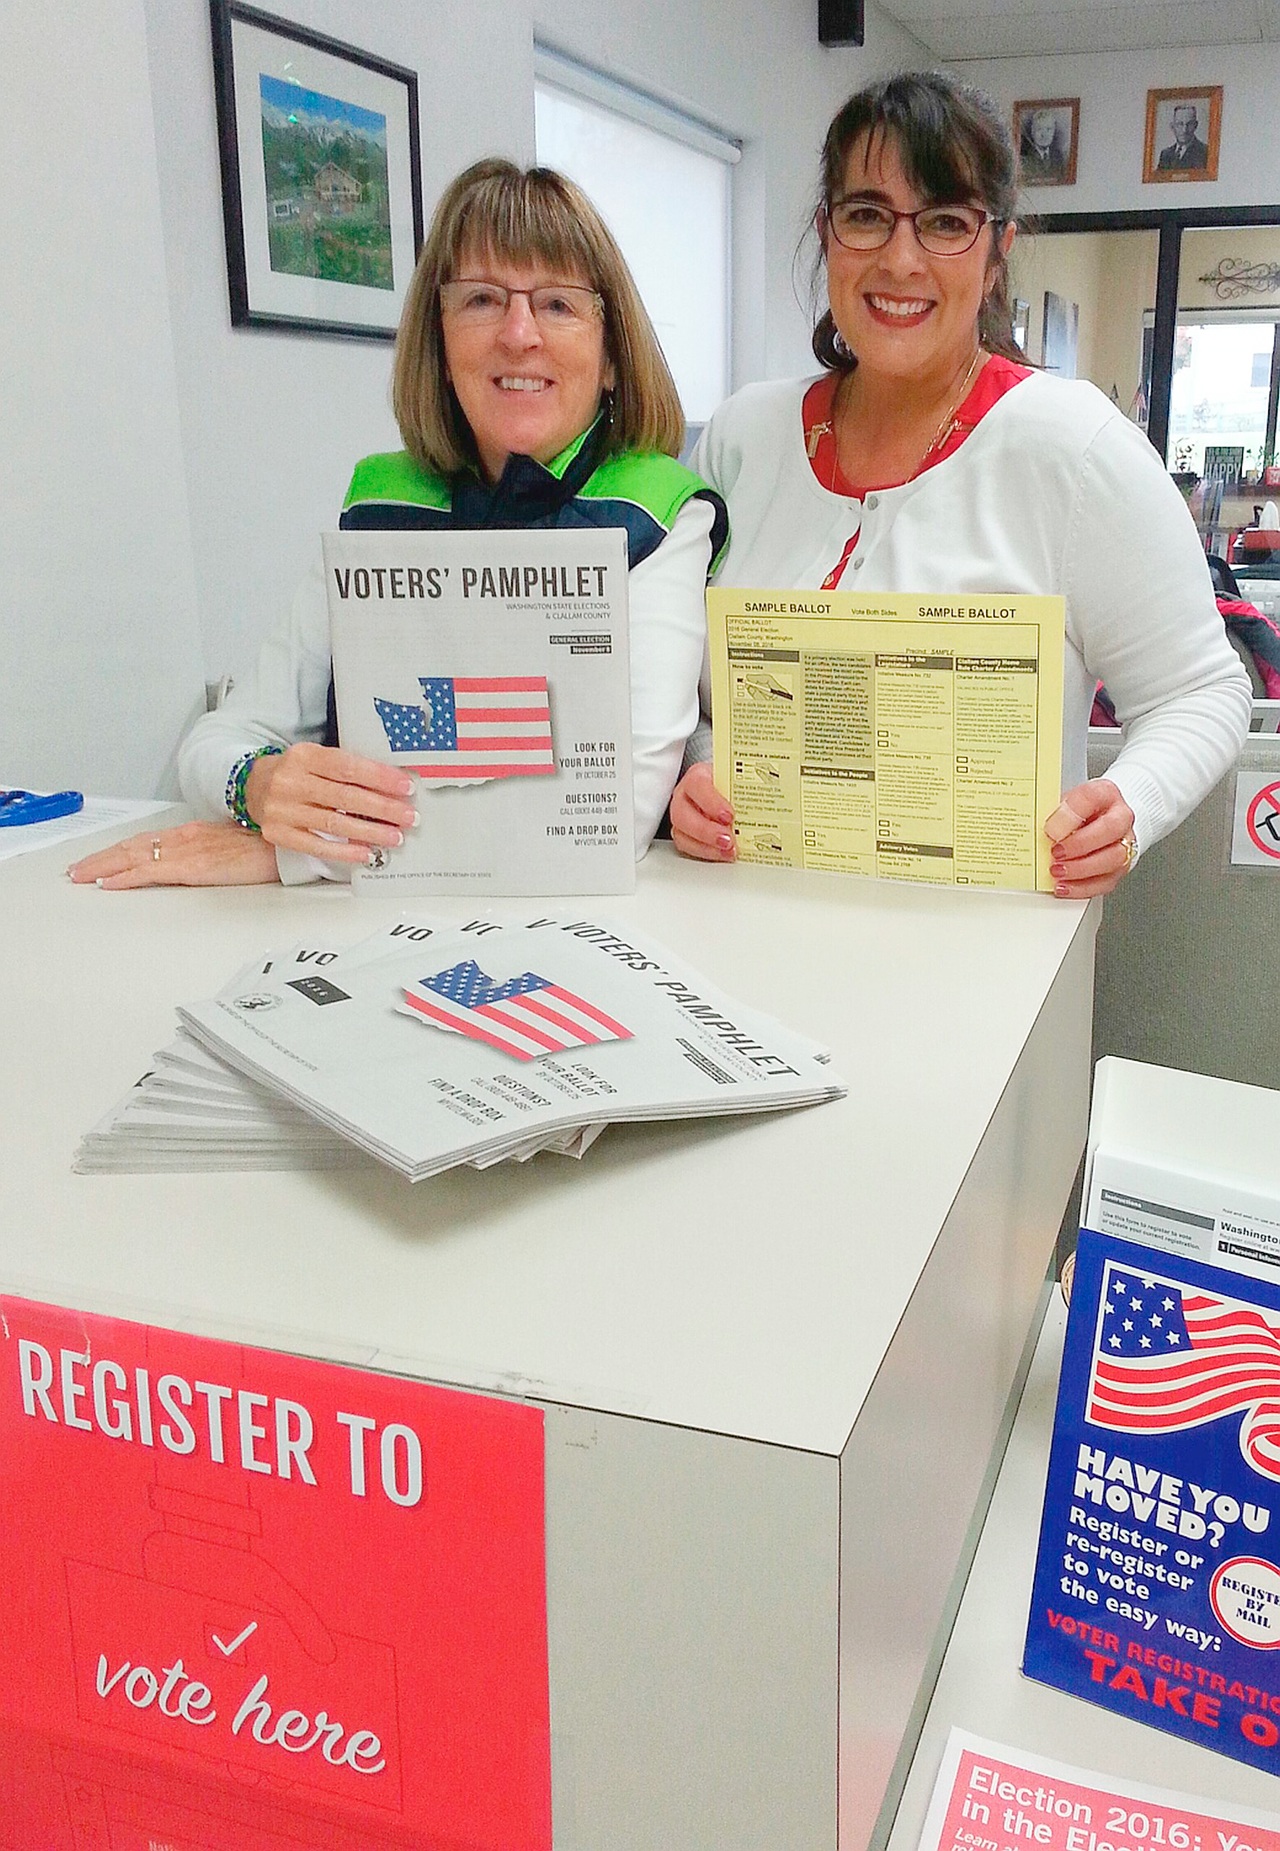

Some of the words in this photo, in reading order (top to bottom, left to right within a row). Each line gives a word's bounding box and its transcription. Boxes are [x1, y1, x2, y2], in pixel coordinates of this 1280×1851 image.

[1205, 463, 1241, 484] HAPPY
[334, 568, 449, 599] VOTERS'
[462, 566, 608, 598] PAMPHLET
[574, 602, 610, 610] ELECTIONS
[745, 602, 786, 613] SAMPLE
[790, 604, 831, 614] BALLOT
[919, 607, 965, 618] SAMPLE
[969, 609, 1016, 619] BALLOT
[560, 758, 581, 768] YOUR
[584, 757, 615, 767] BALLOT
[575, 742, 596, 752] LOOK
[600, 742, 615, 752] FOR
[565, 793, 617, 804] QUESTIONS?
[547, 826, 566, 836] FIND
[569, 826, 574, 835] A
[577, 825, 599, 835] DROP
[601, 825, 618, 835] BOX
[654, 981, 801, 1077] PAMPHLET
[492, 1074, 552, 1108] QUESTIONS?
[537, 1057, 566, 1075] YOUR
[561, 1072, 600, 1098] BALLOT
[571, 1063, 599, 1081] LOOK
[595, 1077, 618, 1095] FOR
[427, 1077, 455, 1093] FIND
[456, 1092, 486, 1110] DROP
[480, 1107, 507, 1122] BOX
[1104, 1192, 1141, 1208] Instructions
[1103, 1211, 1113, 1219] Use
[1115, 1214, 1125, 1222] this
[1126, 1217, 1139, 1226] form
[1148, 1224, 1170, 1236] register
[1109, 1220, 1128, 1231] update
[1129, 1226, 1141, 1235] your
[1142, 1230, 1164, 1240] current
[1221, 1221, 1280, 1244] Washingto
[1230, 1245, 1259, 1259] Personal
[18, 1338, 317, 1486] REGISTER
[336, 1411, 423, 1507] TO
[1077, 1443, 1184, 1505] HAVE
[1188, 1483, 1270, 1533] YOU
[1074, 1470, 1225, 1548] MOVED?
[1069, 1505, 1169, 1557] Register
[1175, 1550, 1204, 1570] or
[1063, 1553, 1090, 1576] to
[1096, 1568, 1150, 1600] vote
[1066, 1531, 1194, 1592] re-register
[1060, 1576, 1099, 1605] the
[1105, 1597, 1159, 1631] easy
[1165, 1618, 1222, 1652] way:
[1236, 1607, 1271, 1629] MAIL
[1246, 1598, 1265, 1612] BY
[1046, 1608, 1120, 1652] VOTER
[1084, 1649, 1222, 1729] TAKE
[96, 1653, 217, 1725] vote
[232, 1674, 386, 1774] here
[969, 1765, 1092, 1825] Election
[962, 1793, 991, 1825] in
[1003, 1808, 1053, 1844] the
[955, 1827, 998, 1851] Learn
